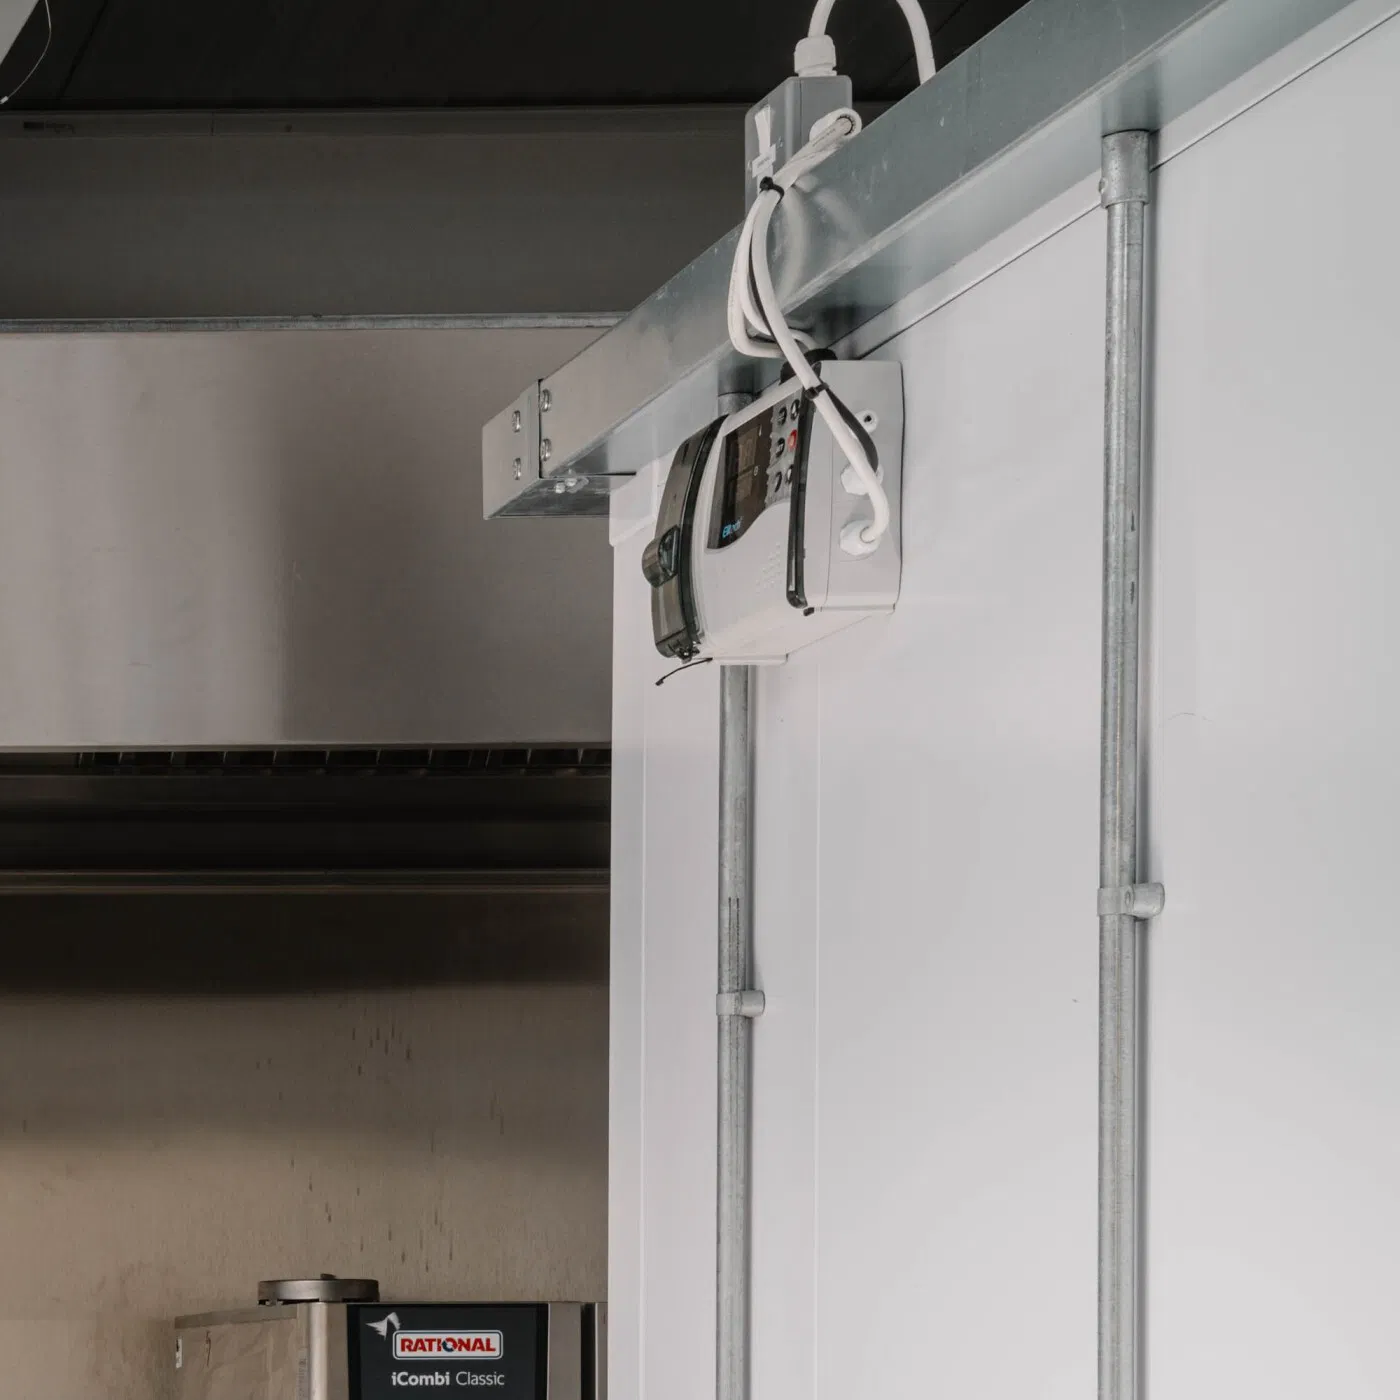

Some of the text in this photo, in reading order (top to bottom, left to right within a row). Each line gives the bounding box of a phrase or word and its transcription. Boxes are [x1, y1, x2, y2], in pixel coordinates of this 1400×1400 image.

[400, 1337, 496, 1352] RATIONAL
[391, 1371, 505, 1386] iCombi Classic
